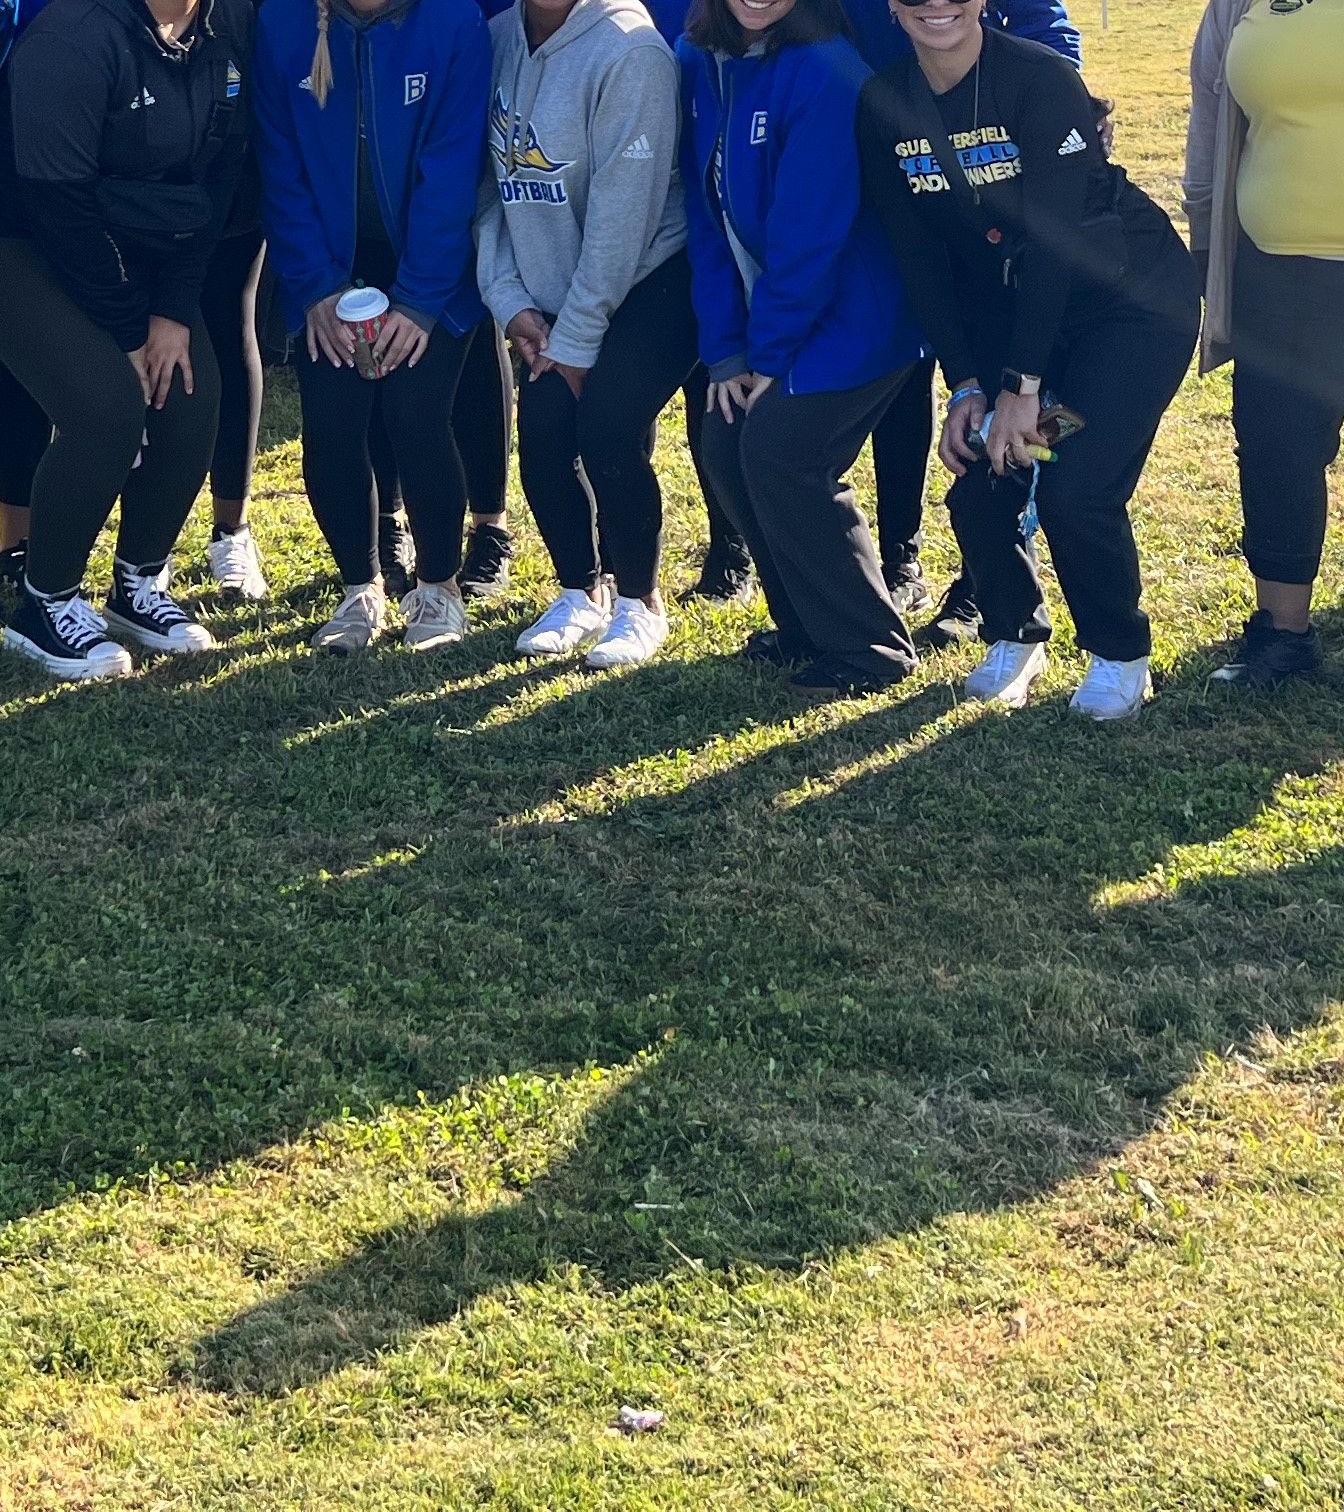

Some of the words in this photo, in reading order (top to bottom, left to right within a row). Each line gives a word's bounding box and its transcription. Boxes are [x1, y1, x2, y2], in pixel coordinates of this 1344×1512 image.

[404, 73, 427, 105] B
[621, 149, 655, 159] adidas
[498, 178, 568, 204] OFTBALL
